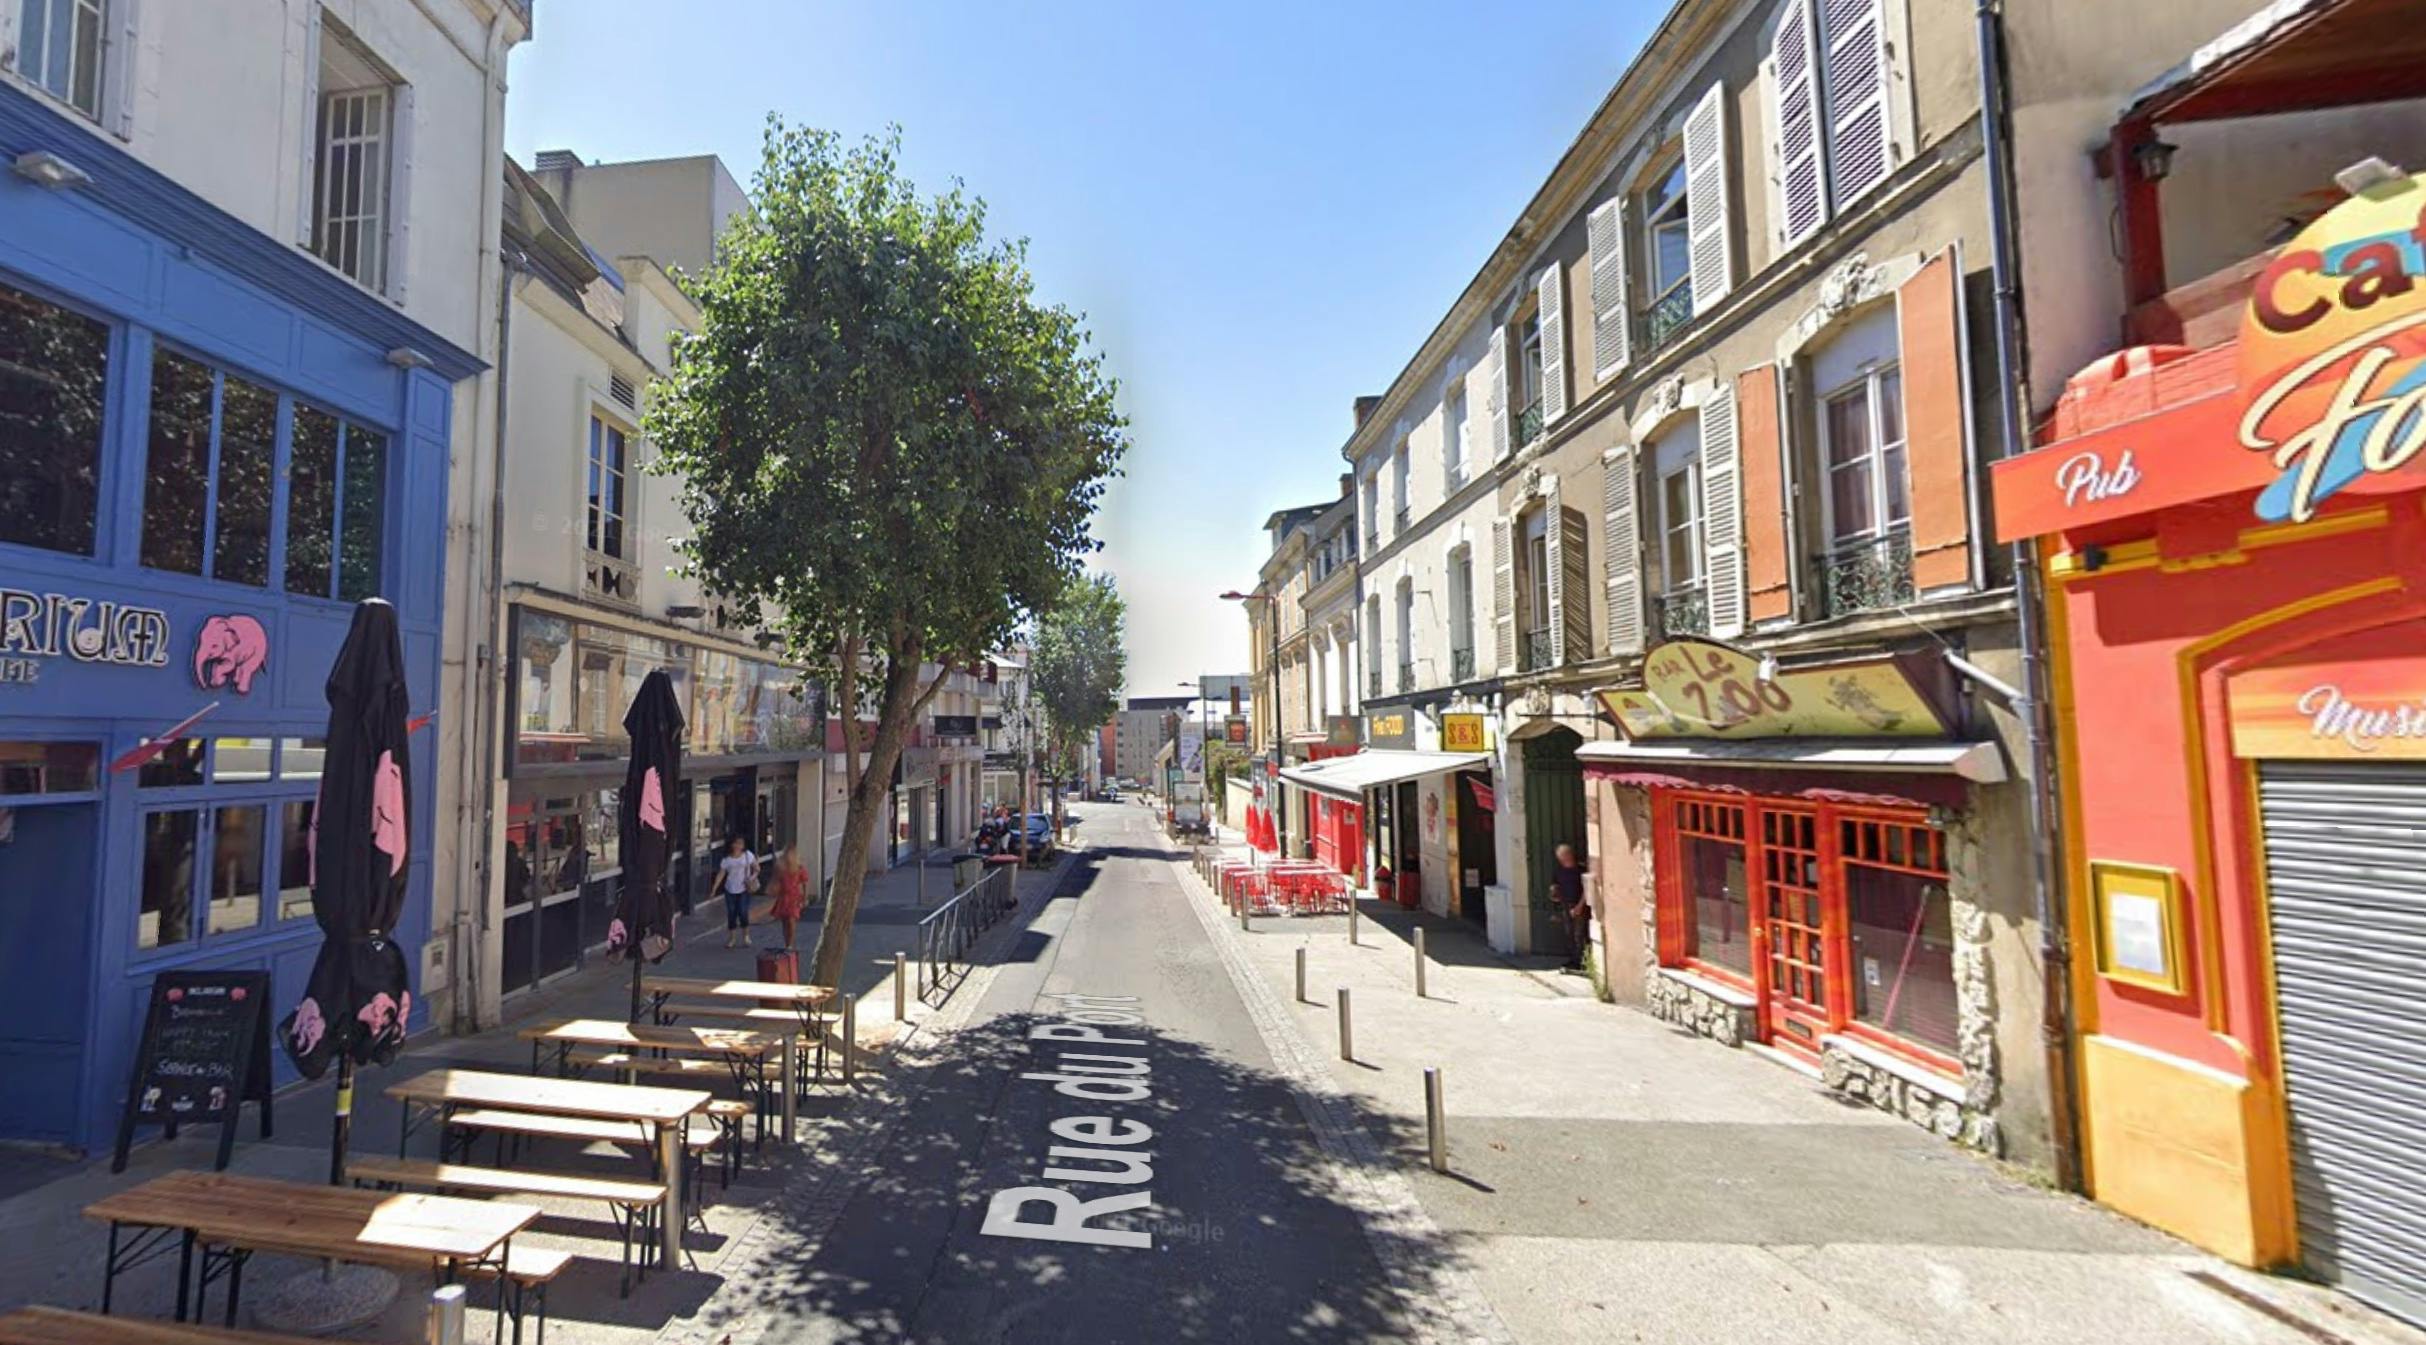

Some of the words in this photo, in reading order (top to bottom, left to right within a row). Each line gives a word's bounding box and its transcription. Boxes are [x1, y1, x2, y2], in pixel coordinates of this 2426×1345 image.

[2253, 205, 2426, 334] Ca
[2055, 449, 2142, 507] Pub
[1678, 645, 1735, 682] Le
